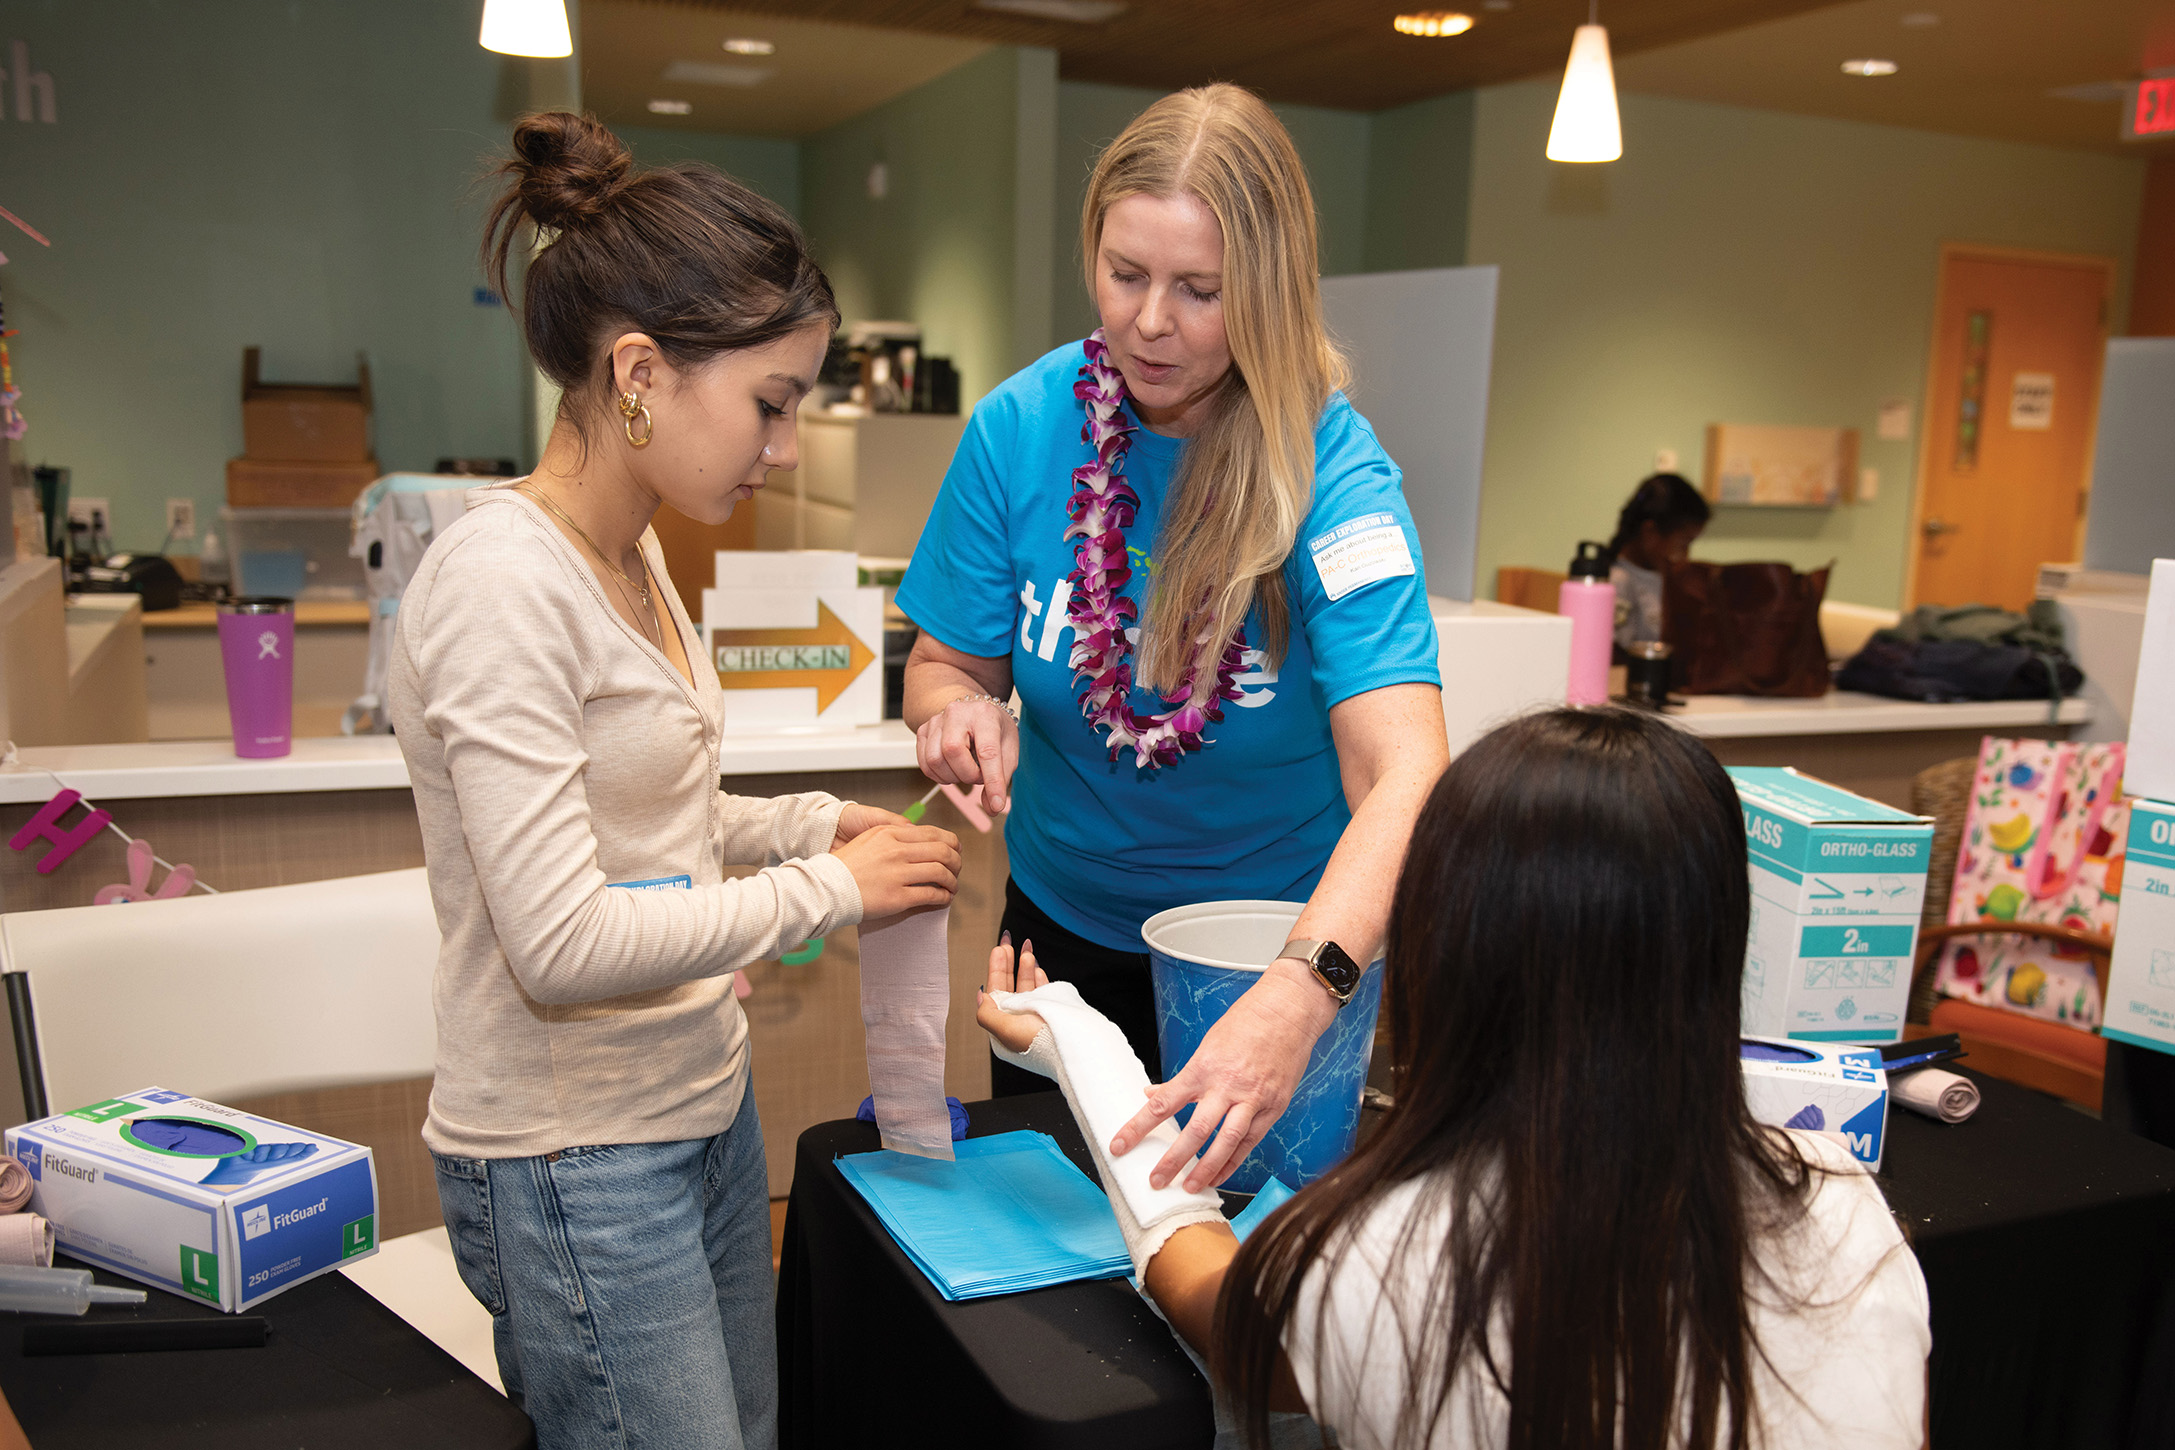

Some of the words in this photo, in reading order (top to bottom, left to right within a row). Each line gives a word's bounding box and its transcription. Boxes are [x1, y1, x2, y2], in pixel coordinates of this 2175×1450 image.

[1311, 531, 1337, 552] CAREER
[1336, 516, 1382, 537] EXPLORATION
[1381, 515, 1394, 524] DAY
[1320, 551, 1333, 563] Ask
[1333, 546, 1345, 556] me
[1346, 537, 1366, 550] about
[1367, 531, 1388, 544] being
[1321, 559, 1346, 579] PA-C
[1347, 543, 1407, 564] Orthopedics
[1021, 578, 1278, 708] the
[720, 646, 847, 670] CHECK-IN
[9, 788, 113, 874] H
[1820, 842, 1917, 857] ORTHO-GLASS
[2145, 877, 2169, 895] 2in
[1842, 928, 1869, 953] 2in
[1844, 1056, 1871, 1068] M
[92, 1102, 124, 1115] L
[44, 1123, 67, 1134] 250
[1846, 1131, 1873, 1158] M
[354, 1223, 366, 1245] L
[349, 1244, 367, 1255] NITRILE
[193, 1253, 209, 1285] L
[270, 1259, 290, 1272] POWDER
[290, 1256, 302, 1266] FREE
[270, 1268, 284, 1278] EXAM
[284, 1262, 302, 1273] GLOVES
[248, 1269, 270, 1288] 250
[191, 1287, 212, 1300] NITRILE
